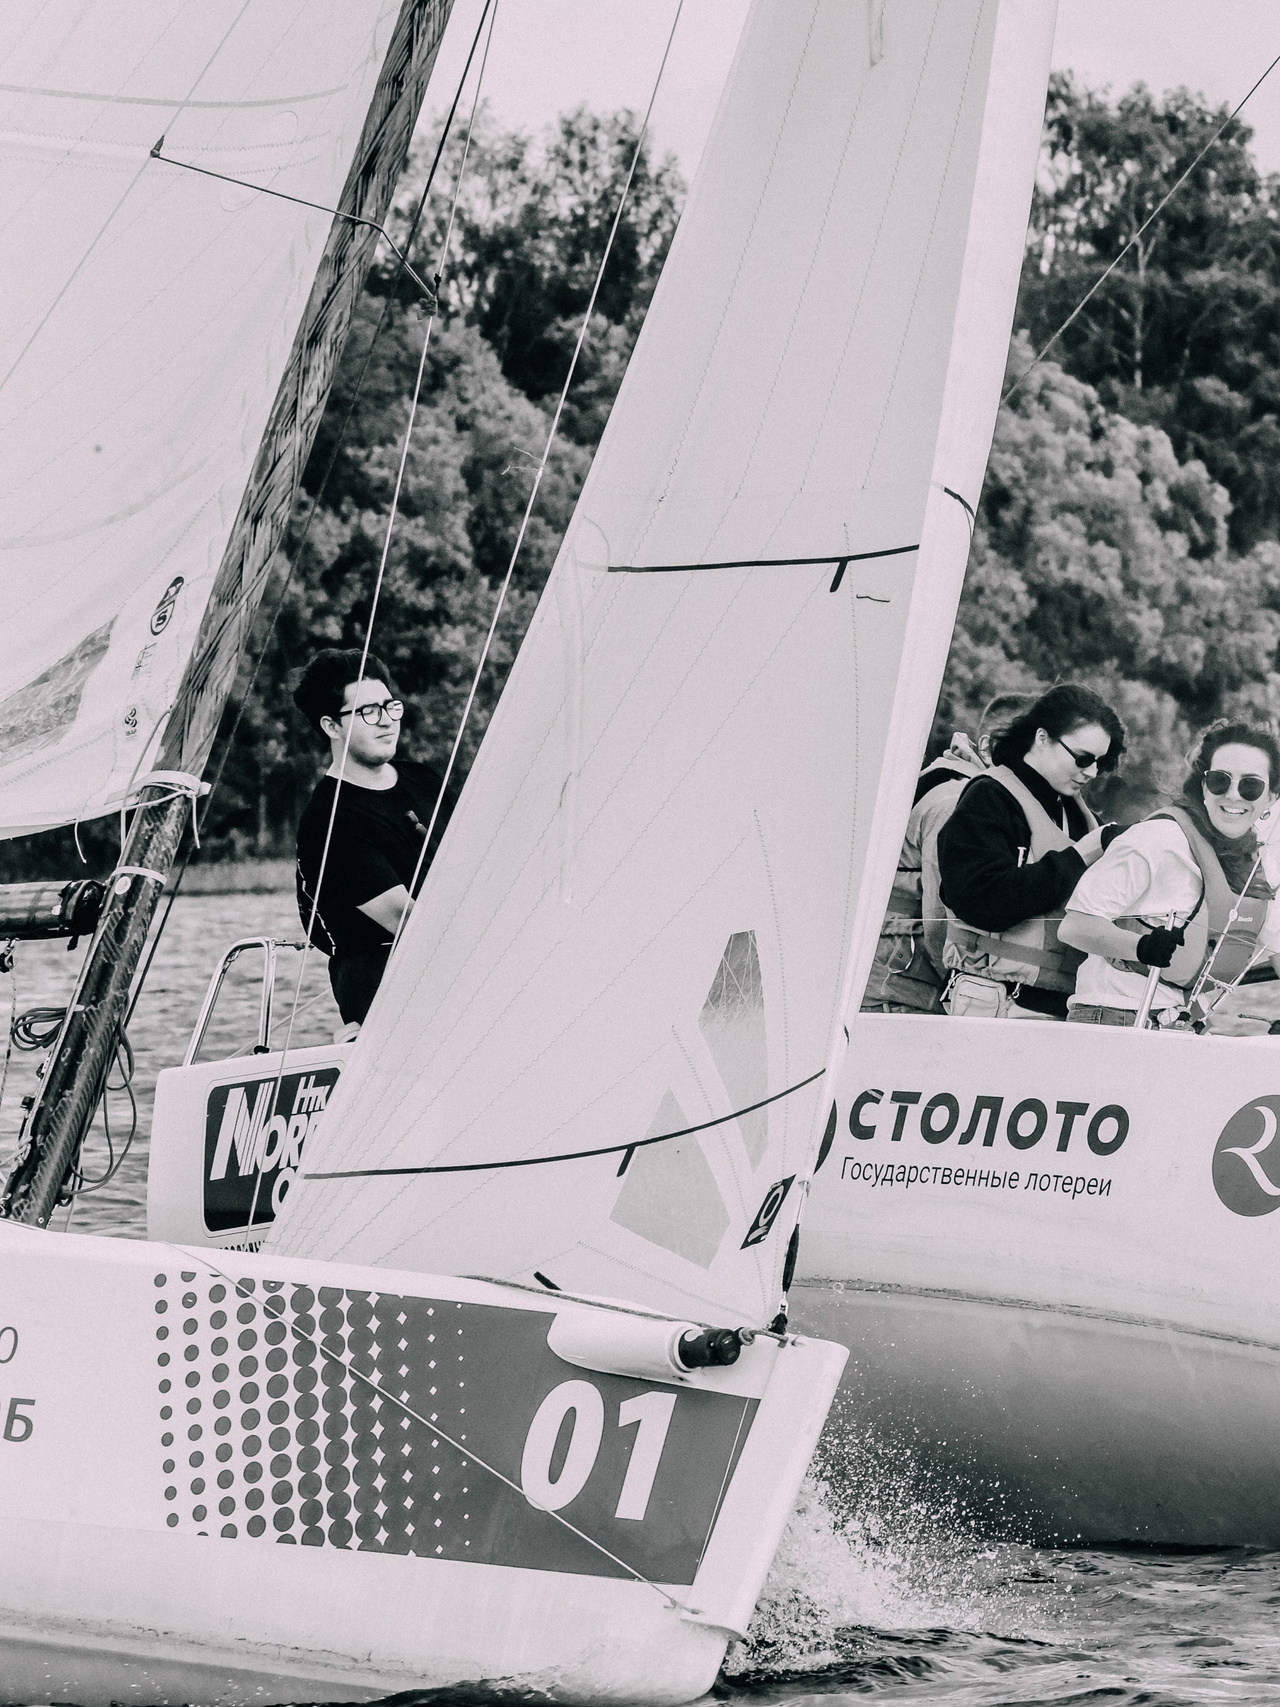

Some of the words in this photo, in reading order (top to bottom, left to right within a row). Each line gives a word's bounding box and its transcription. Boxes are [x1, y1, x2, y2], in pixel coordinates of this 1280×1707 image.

[840, 1156, 1020, 1189] Государственные
[1023, 1172, 1113, 1200] лотереи
[520, 1379, 678, 1521] 01
